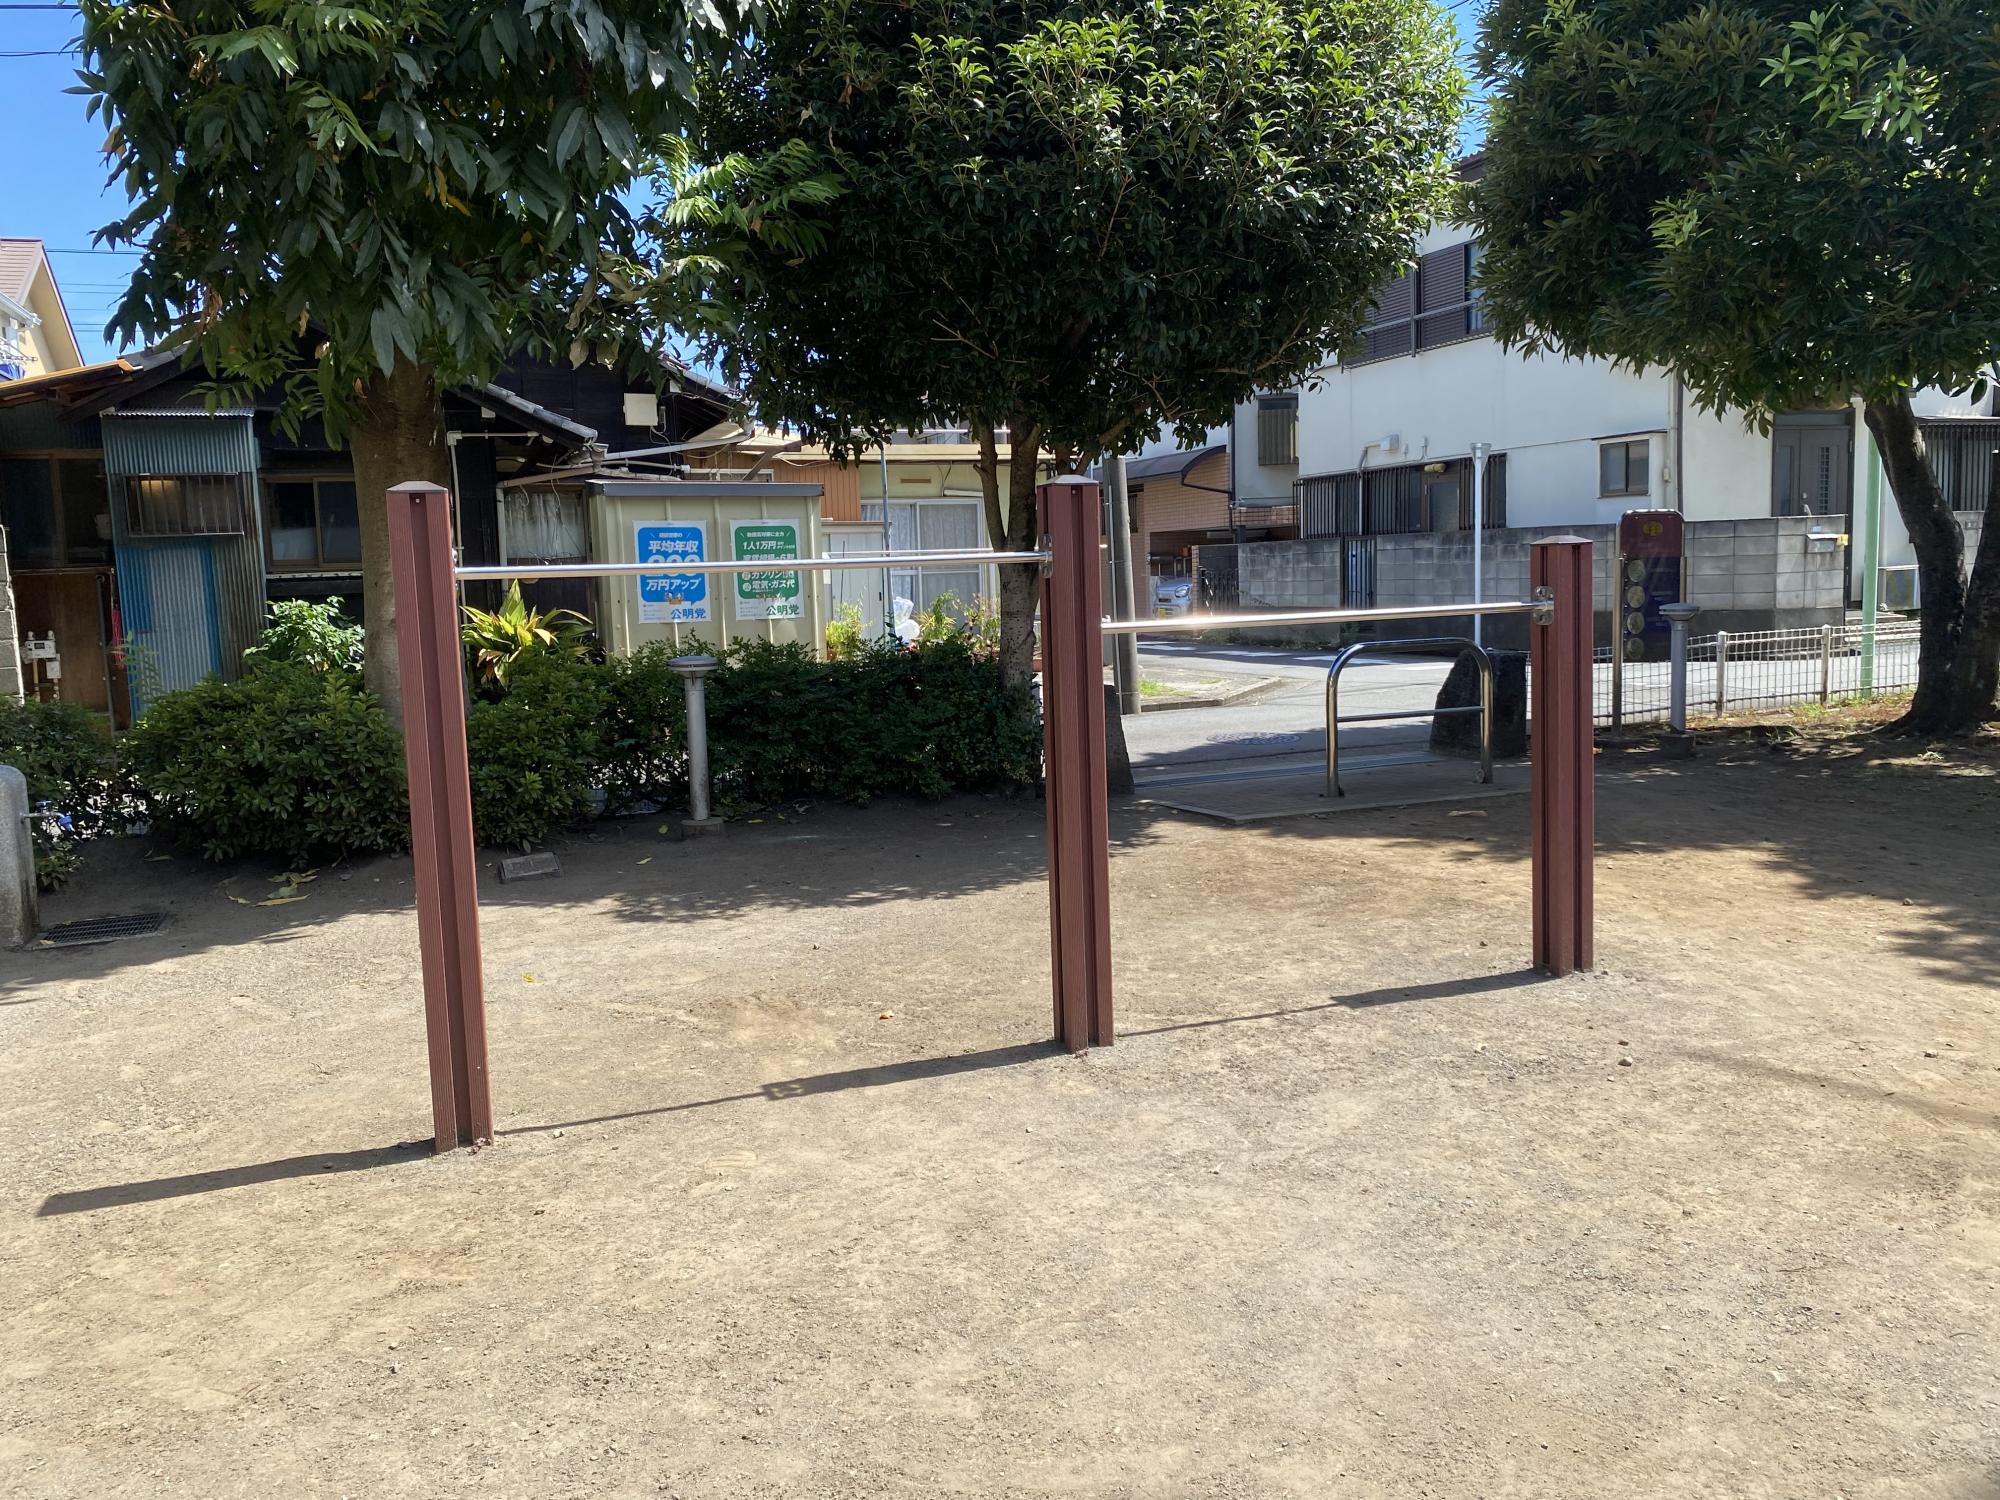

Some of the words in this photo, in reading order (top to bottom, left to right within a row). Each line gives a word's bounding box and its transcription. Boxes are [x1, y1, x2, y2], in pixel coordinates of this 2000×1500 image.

[648, 540, 699, 553] 平均年収
[743, 541, 776, 550] 1人1万円
[646, 577, 701, 591] 万円アップ
[671, 608, 706, 619] 公明党
[766, 604, 799, 615] 公明党
